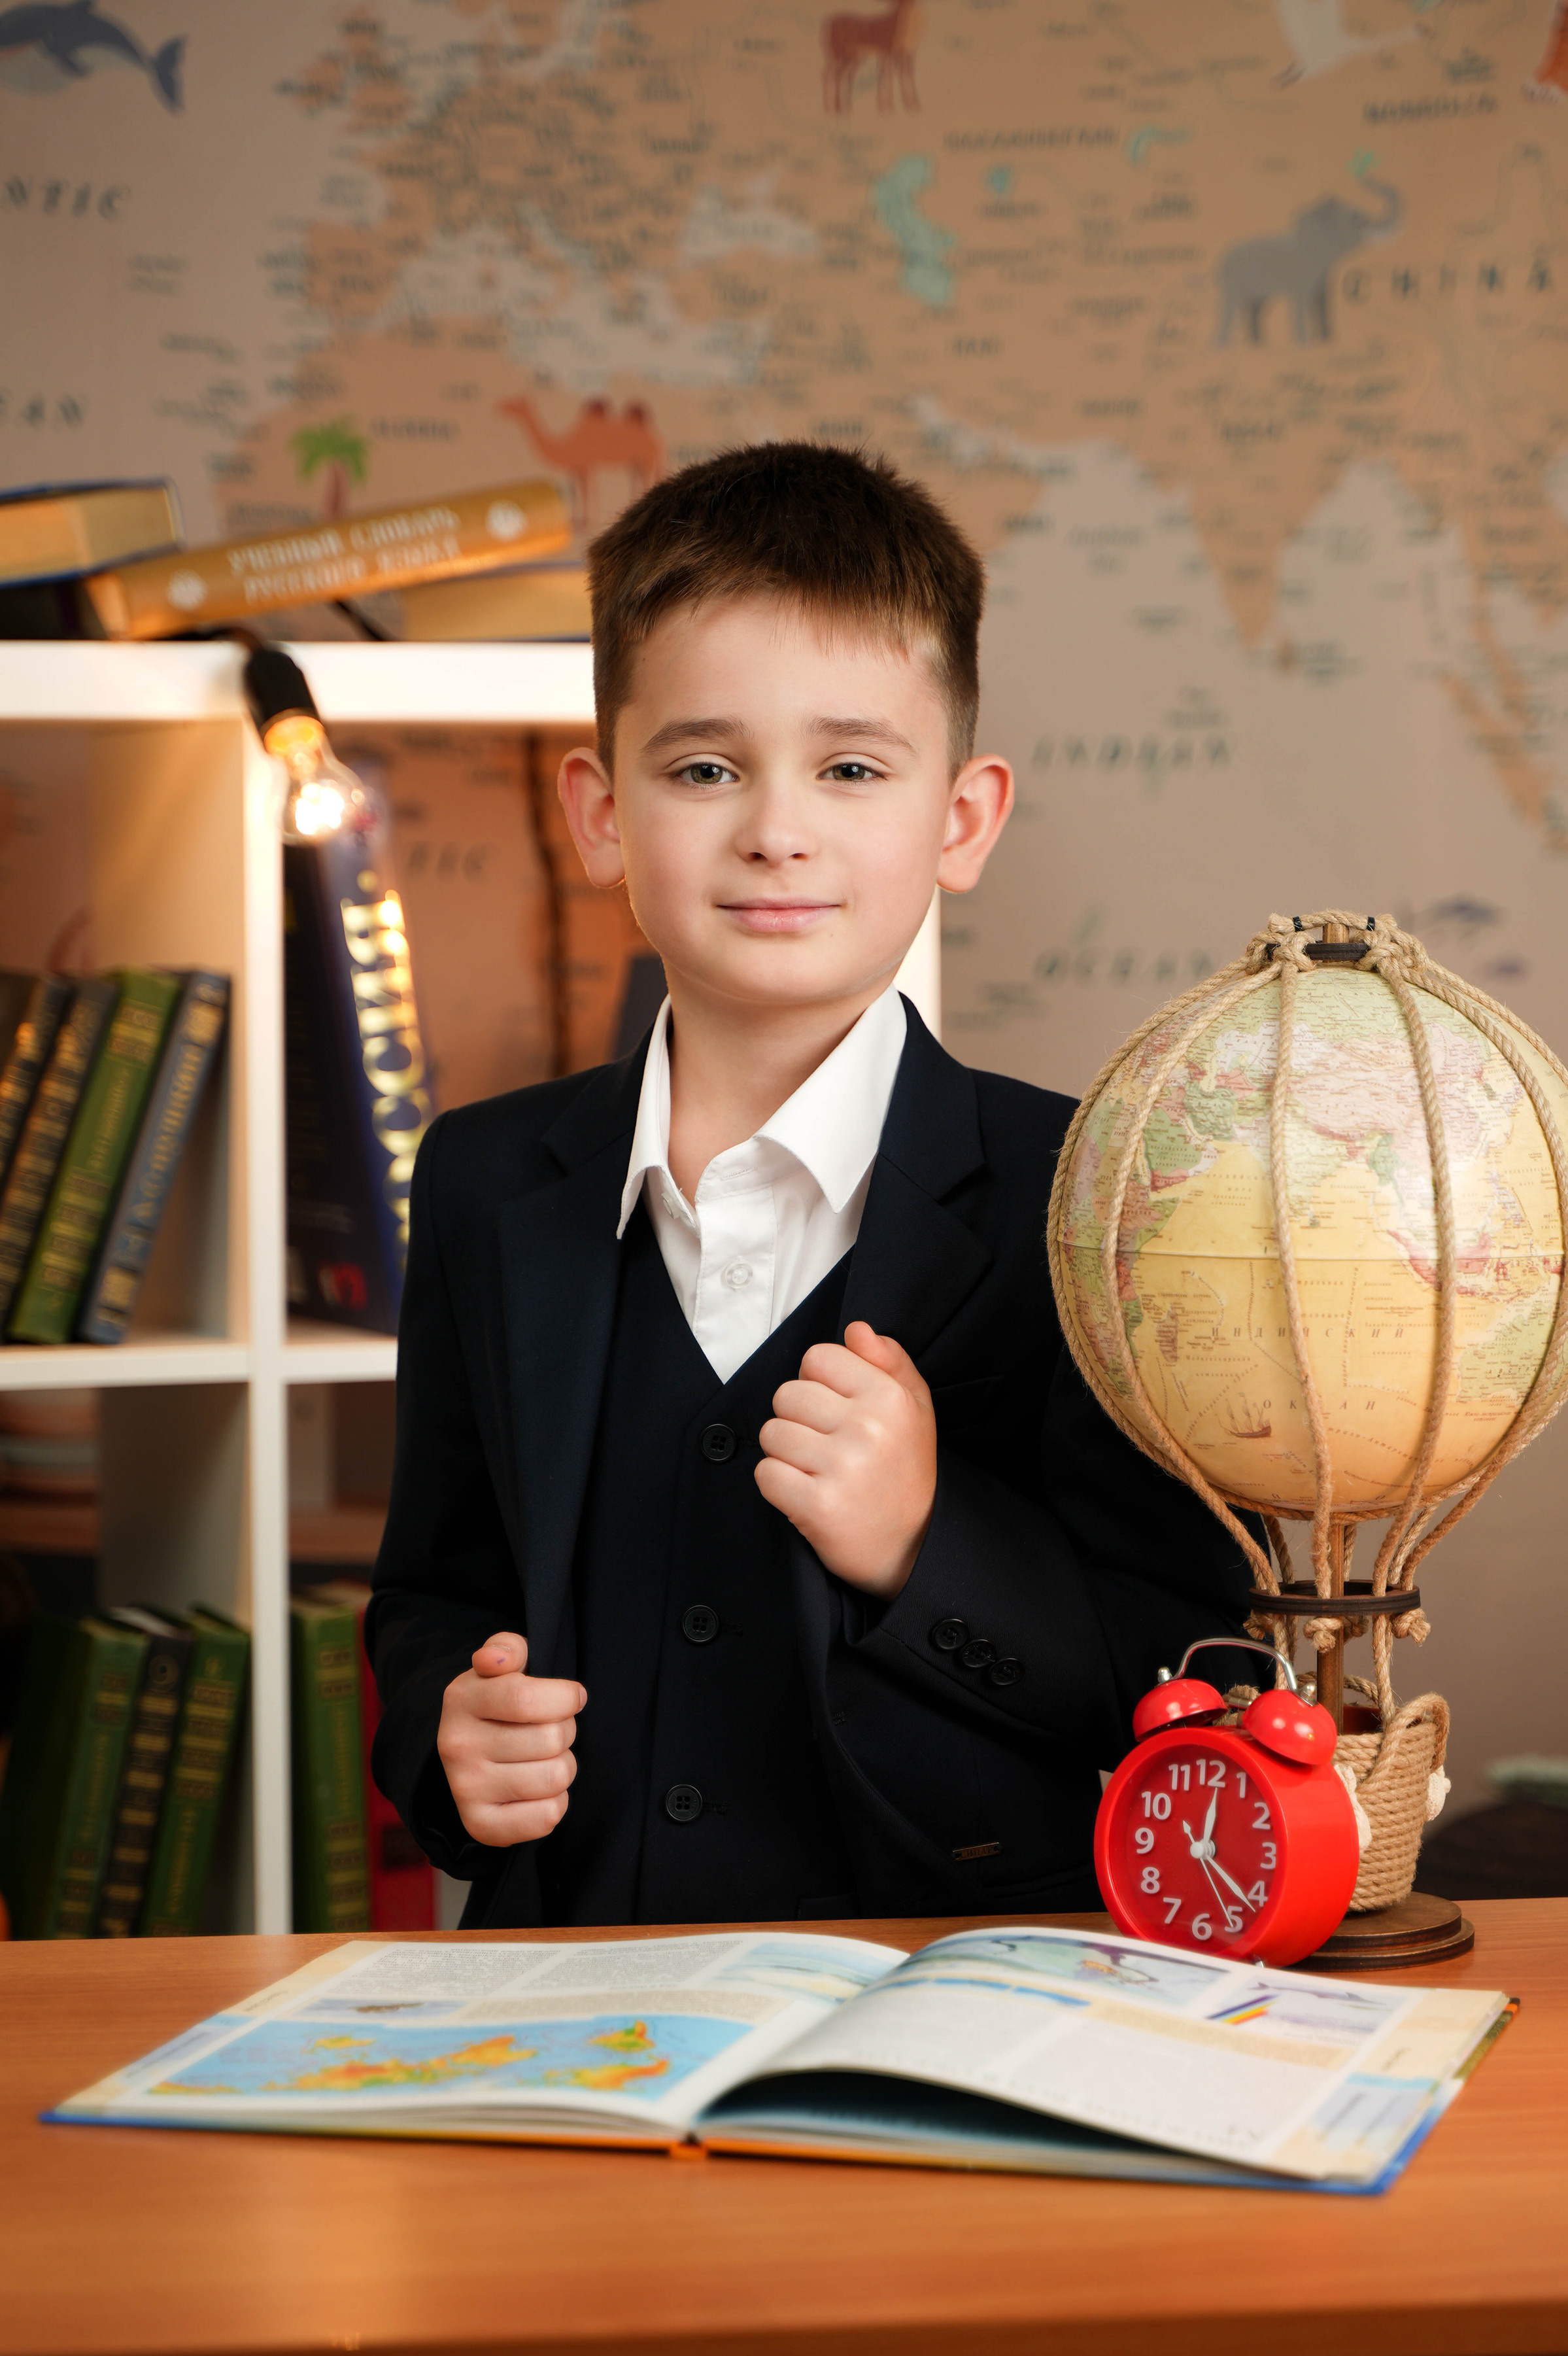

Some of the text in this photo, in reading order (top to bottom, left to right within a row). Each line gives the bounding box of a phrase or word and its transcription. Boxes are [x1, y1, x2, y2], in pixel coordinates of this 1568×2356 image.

[1263, 1399, 1376, 1411] ОКАН
[1168, 1763, 1191, 1792] 11
[1196, 1758, 1226, 1788] 12
[1236, 1771, 1246, 1799] 1
[1141, 1790, 1172, 1820] 10
[1252, 1802, 1271, 1829] 2
[1134, 1827, 1155, 1854] 9
[1259, 1841, 1276, 1870] 3
[1140, 1866, 1161, 1895] 8
[1247, 1880, 1269, 1907] 4
[1162, 1897, 1182, 1924] 7
[1224, 1905, 1244, 1933] 5
[1191, 1913, 1212, 1941] 6
